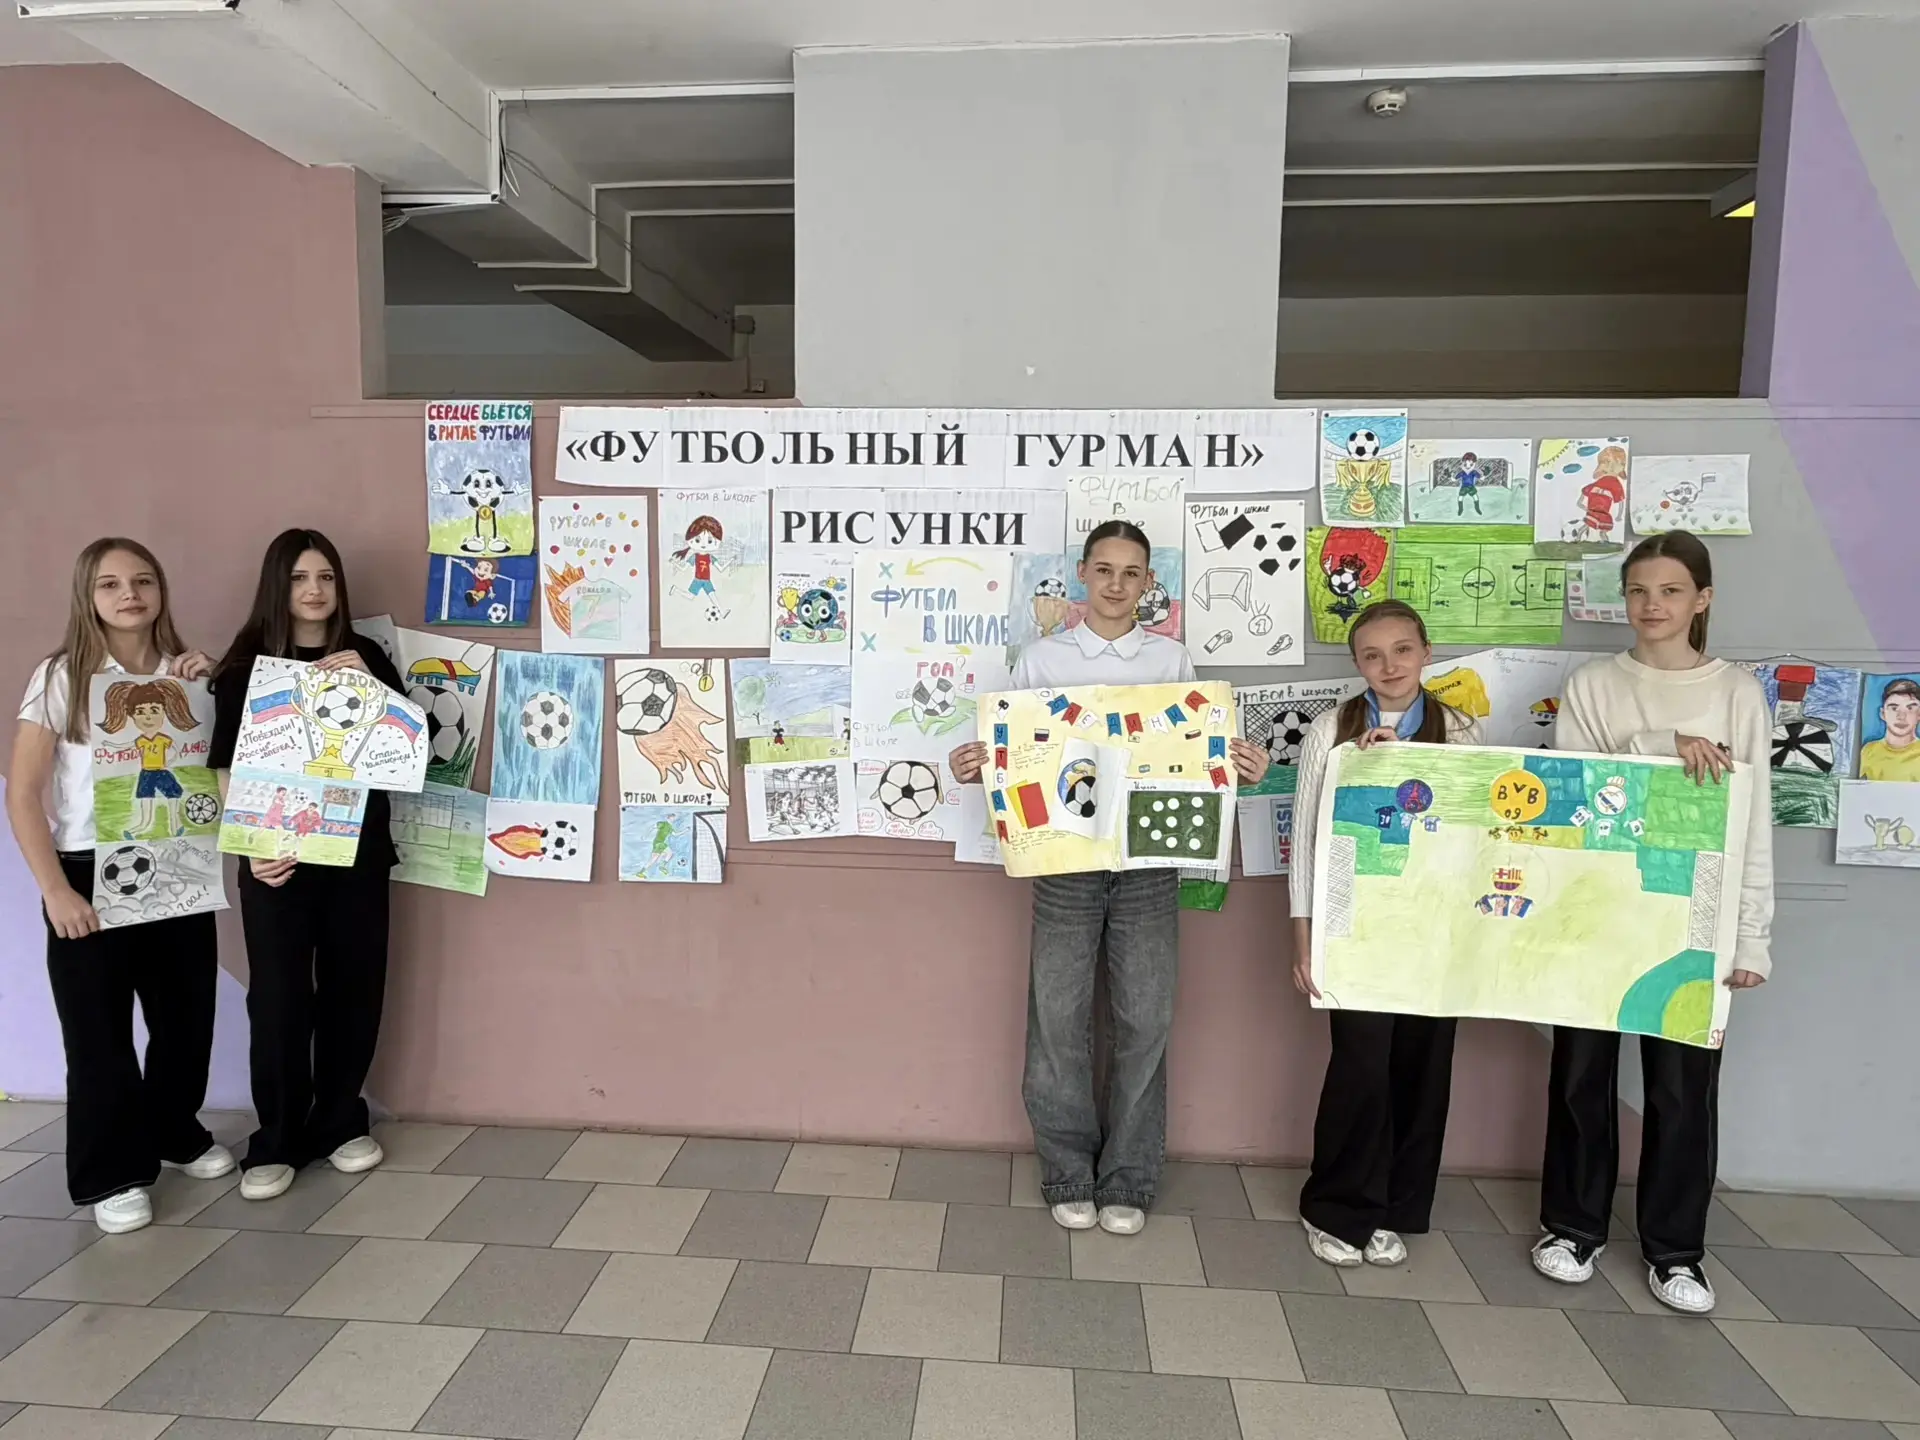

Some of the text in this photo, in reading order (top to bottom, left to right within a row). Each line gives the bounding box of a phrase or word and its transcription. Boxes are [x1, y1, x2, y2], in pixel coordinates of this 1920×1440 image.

[428, 404, 480, 421] СЕРДЦЕ
[428, 424, 437, 441] В
[565, 423, 1264, 468] «ФУТБОЛЬНЫЙ ГУРМАН»
[779, 511, 1028, 546] РИСУНКИ
